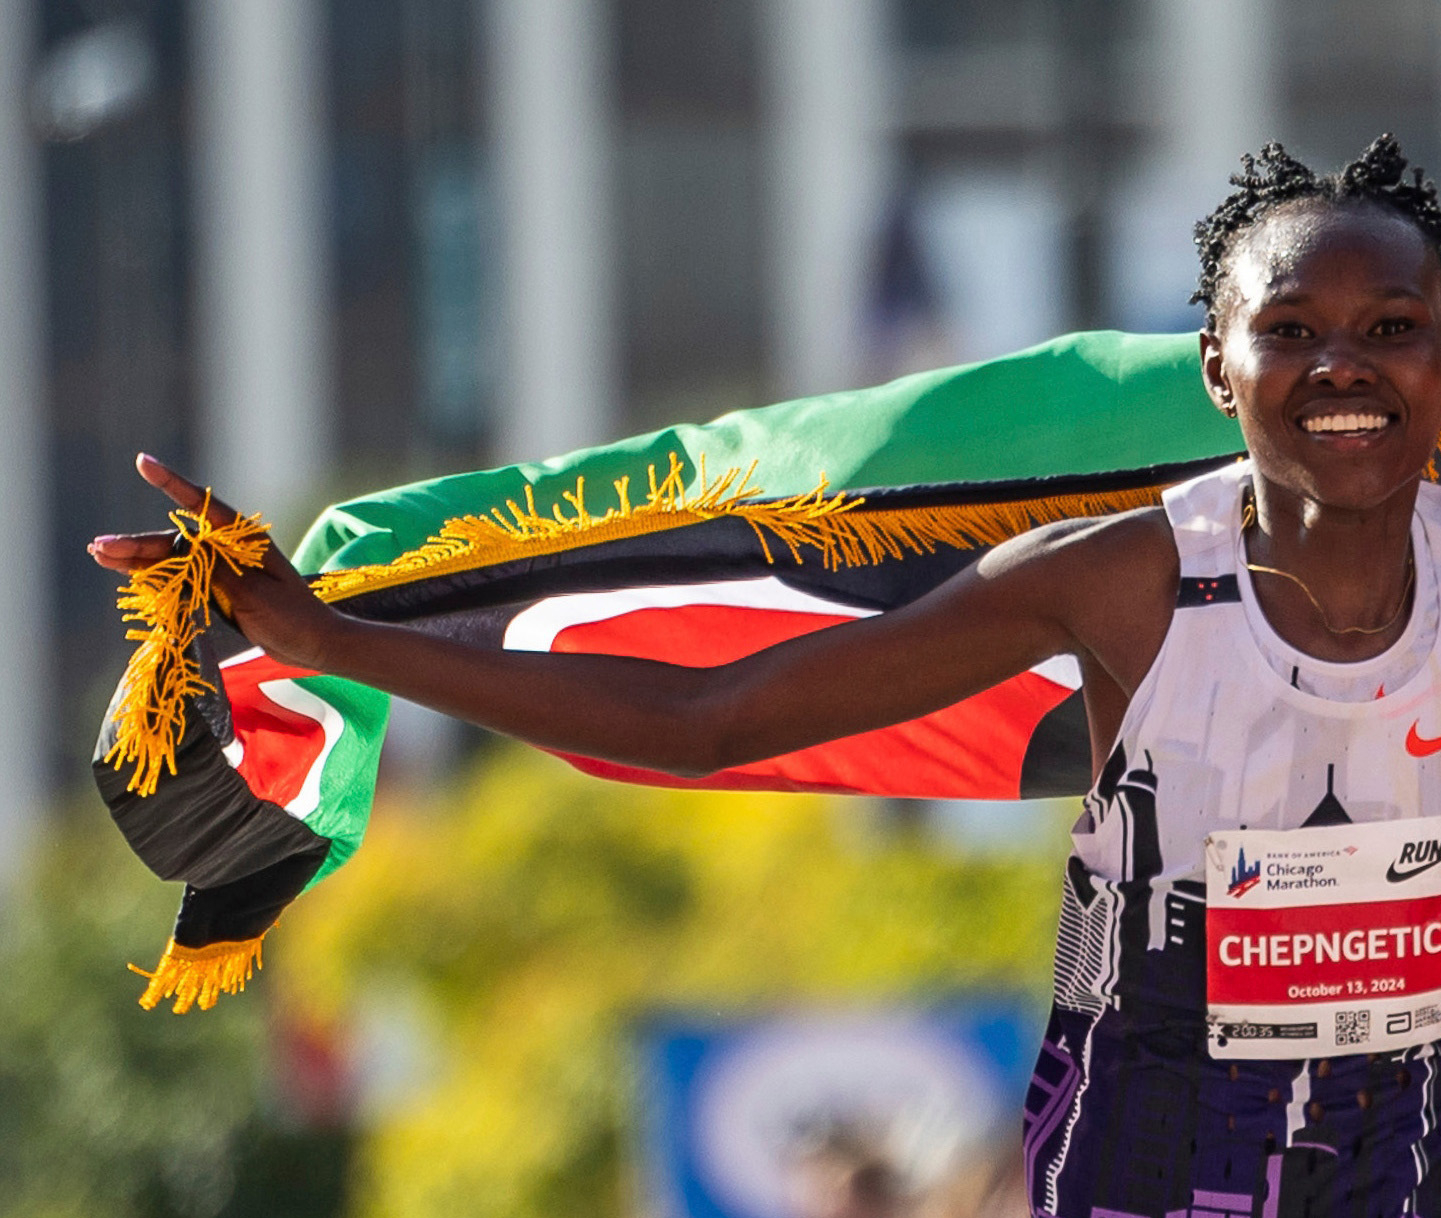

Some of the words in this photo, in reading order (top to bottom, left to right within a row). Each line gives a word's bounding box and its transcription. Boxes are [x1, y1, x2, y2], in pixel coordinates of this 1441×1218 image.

[1266, 863, 1324, 877] Chicago
[1266, 876, 1337, 891] Marathon
[1288, 983, 1343, 998] October
[1346, 980, 1368, 995] 13,
[1371, 977, 1405, 993] 2024
